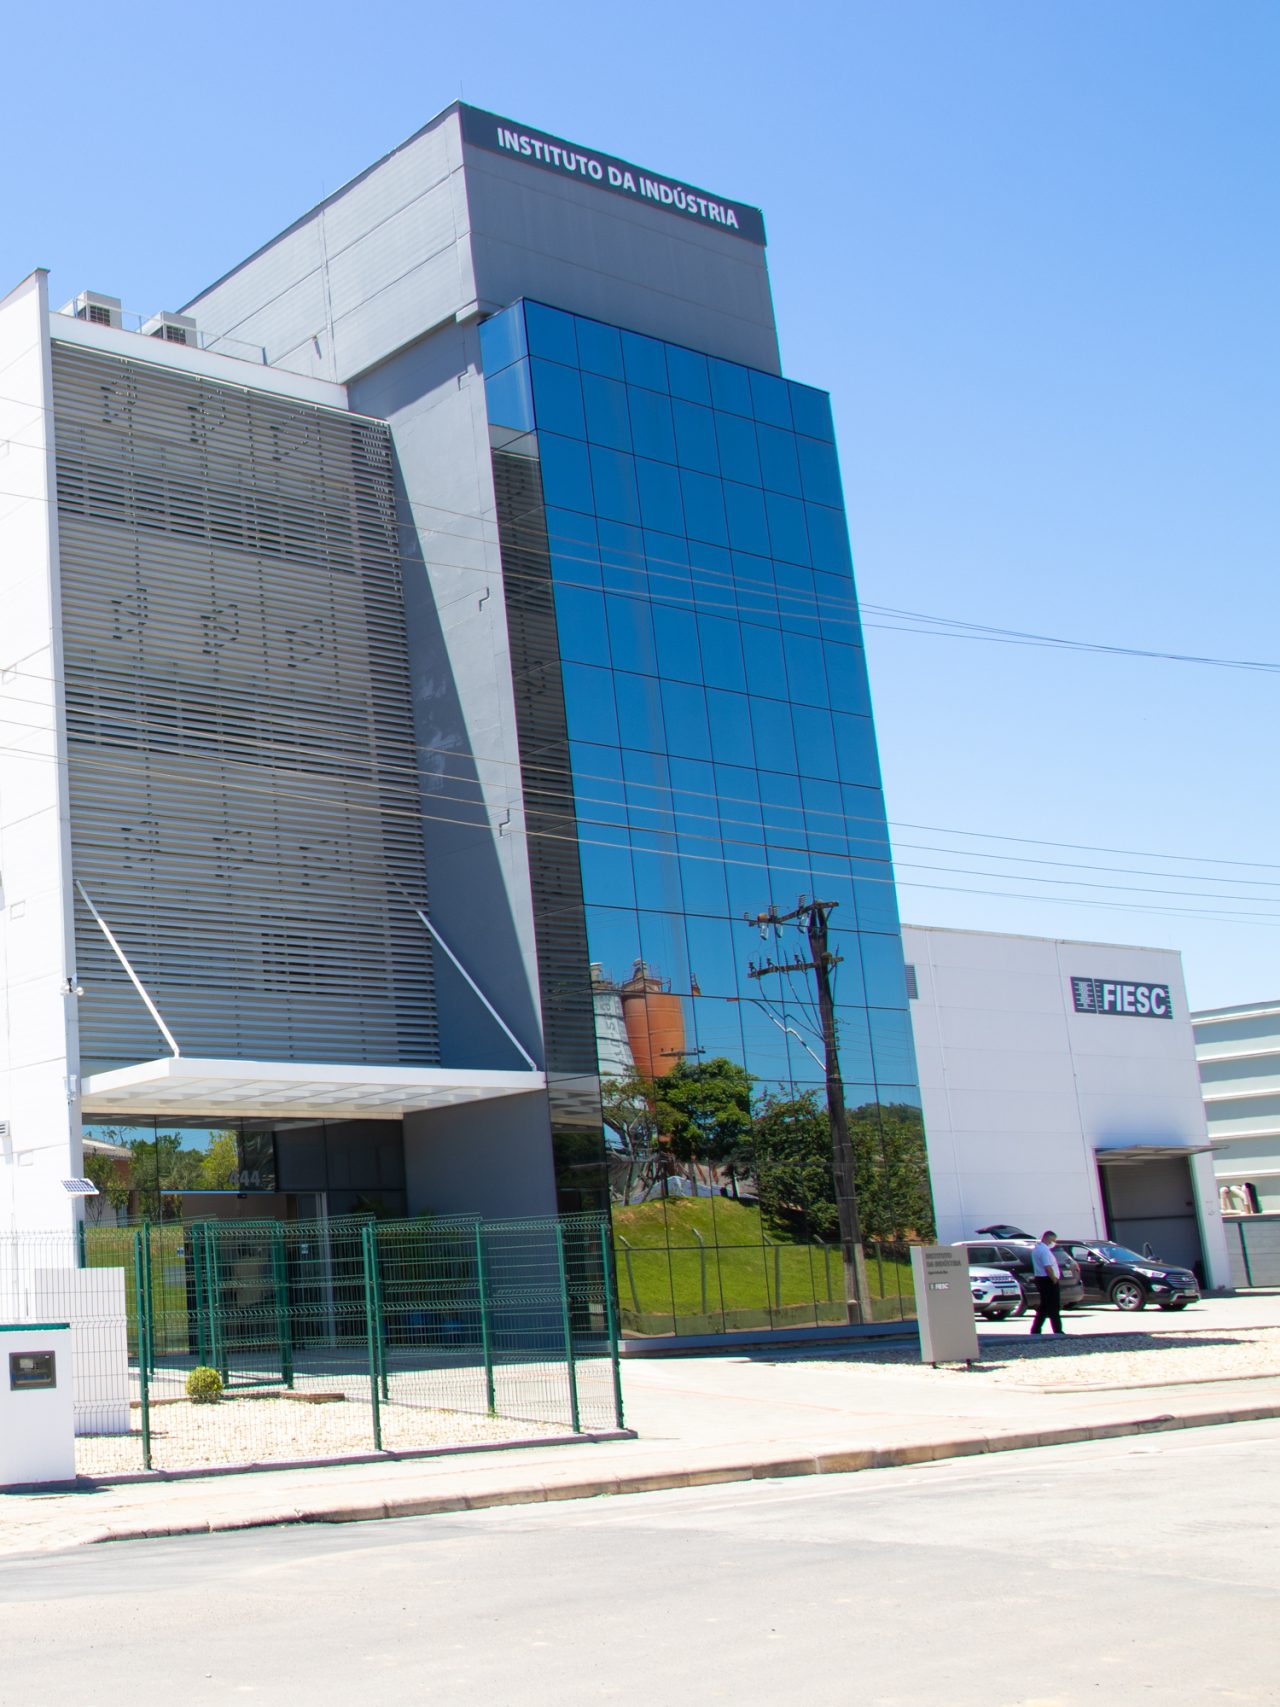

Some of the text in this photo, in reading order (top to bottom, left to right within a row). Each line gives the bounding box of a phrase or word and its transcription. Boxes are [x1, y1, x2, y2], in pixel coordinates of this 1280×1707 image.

[497, 127, 740, 229] INSTITUTO DA INDÚSTRIA
[1102, 983, 1167, 1015] FIESC
